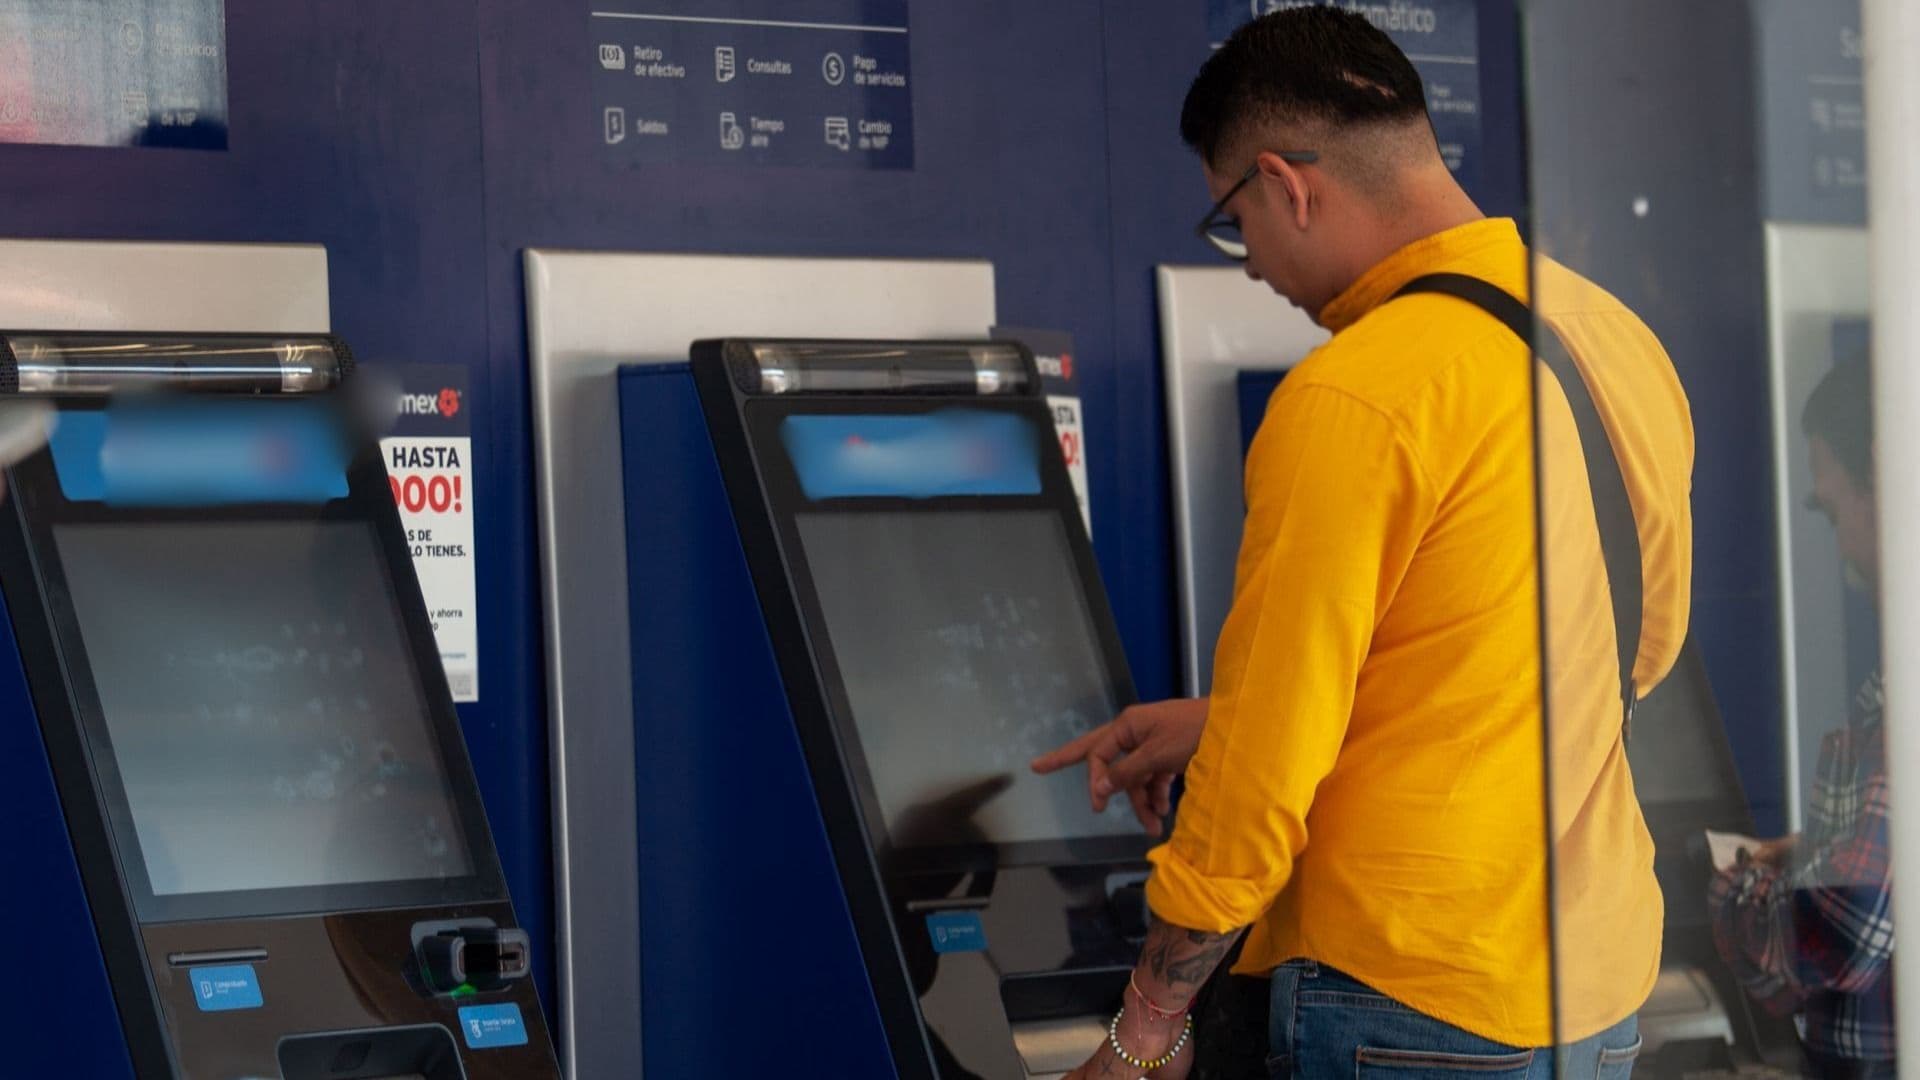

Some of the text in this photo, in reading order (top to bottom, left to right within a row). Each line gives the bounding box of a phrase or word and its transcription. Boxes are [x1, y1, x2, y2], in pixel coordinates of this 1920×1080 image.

[1325, 0, 1436, 33] mático
[634, 46, 663, 61] Retiro
[635, 63, 686, 78] de efectivo
[747, 58, 792, 75] Consultas
[854, 55, 877, 72] Pago
[855, 72, 906, 87] de servicios
[637, 119, 668, 135] Saldos
[751, 117, 784, 132] Tiempo
[859, 119, 892, 134] Cambio
[392, 447, 460, 468] HASTA
[418, 530, 432, 541] DE
[426, 545, 466, 557] TIENES.
[437, 608, 463, 618] ahorra
